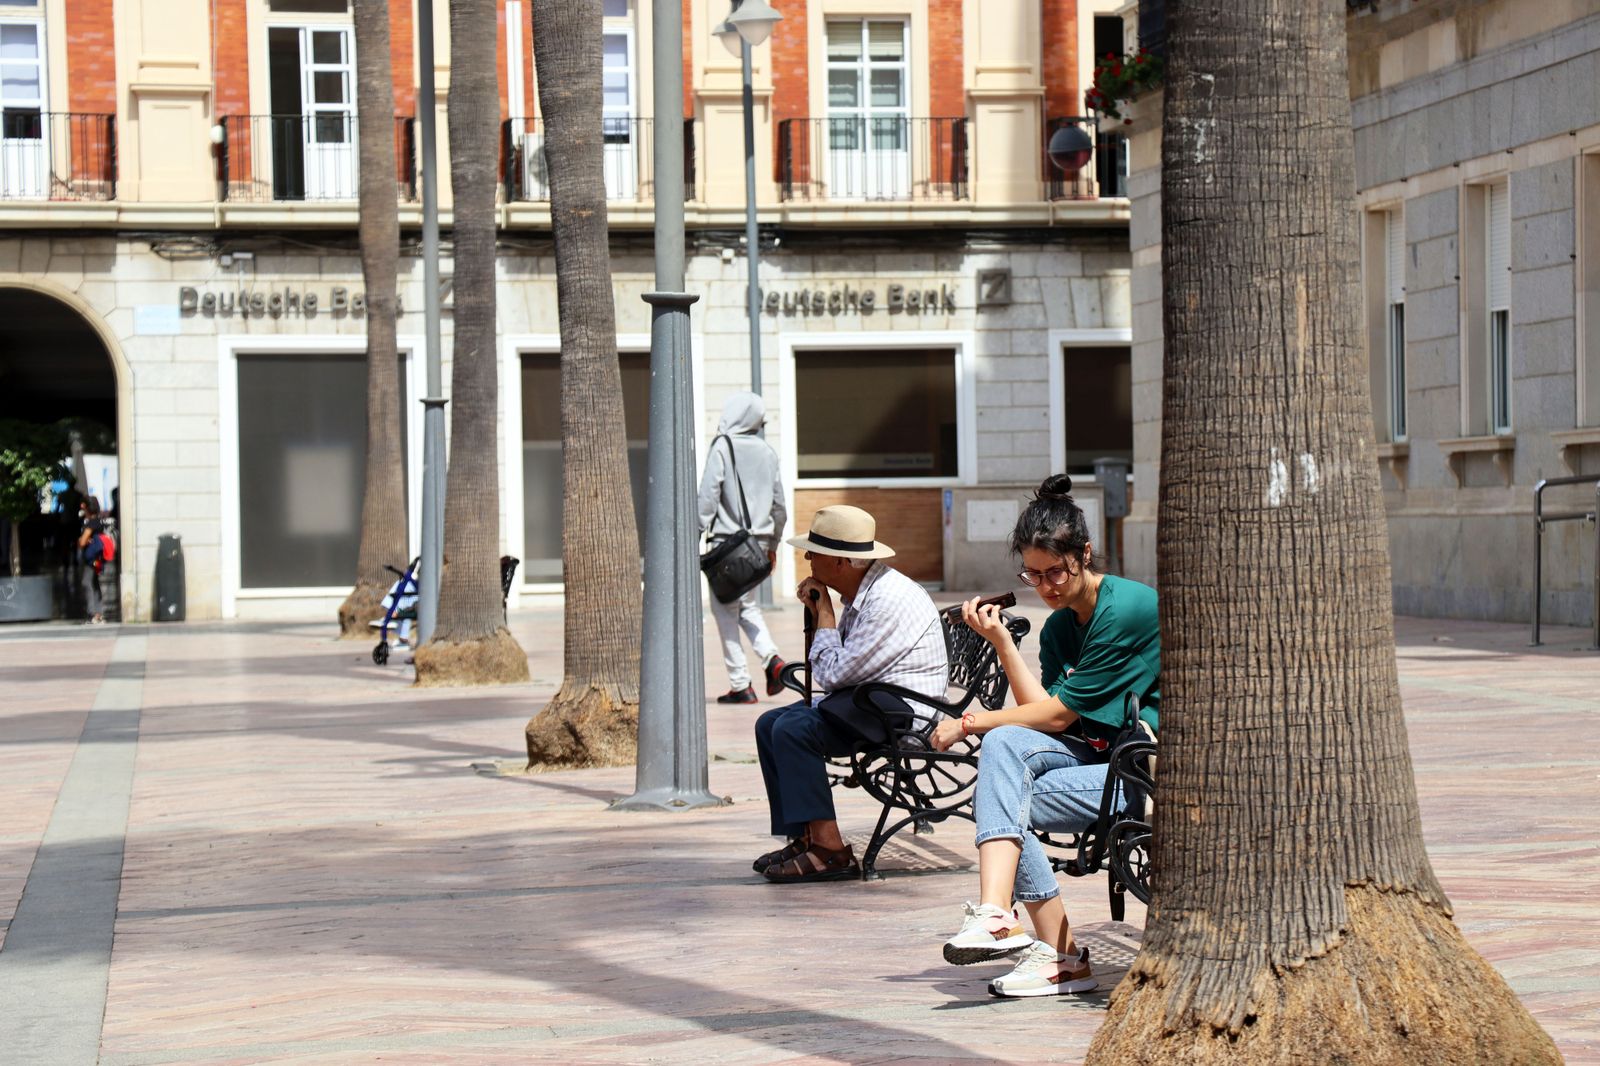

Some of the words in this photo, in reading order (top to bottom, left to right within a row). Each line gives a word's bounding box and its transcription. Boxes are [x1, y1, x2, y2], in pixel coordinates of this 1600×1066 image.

[179, 286, 318, 311] Deutsche
[330, 286, 402, 311] Ba
[888, 284, 955, 310] Bank
